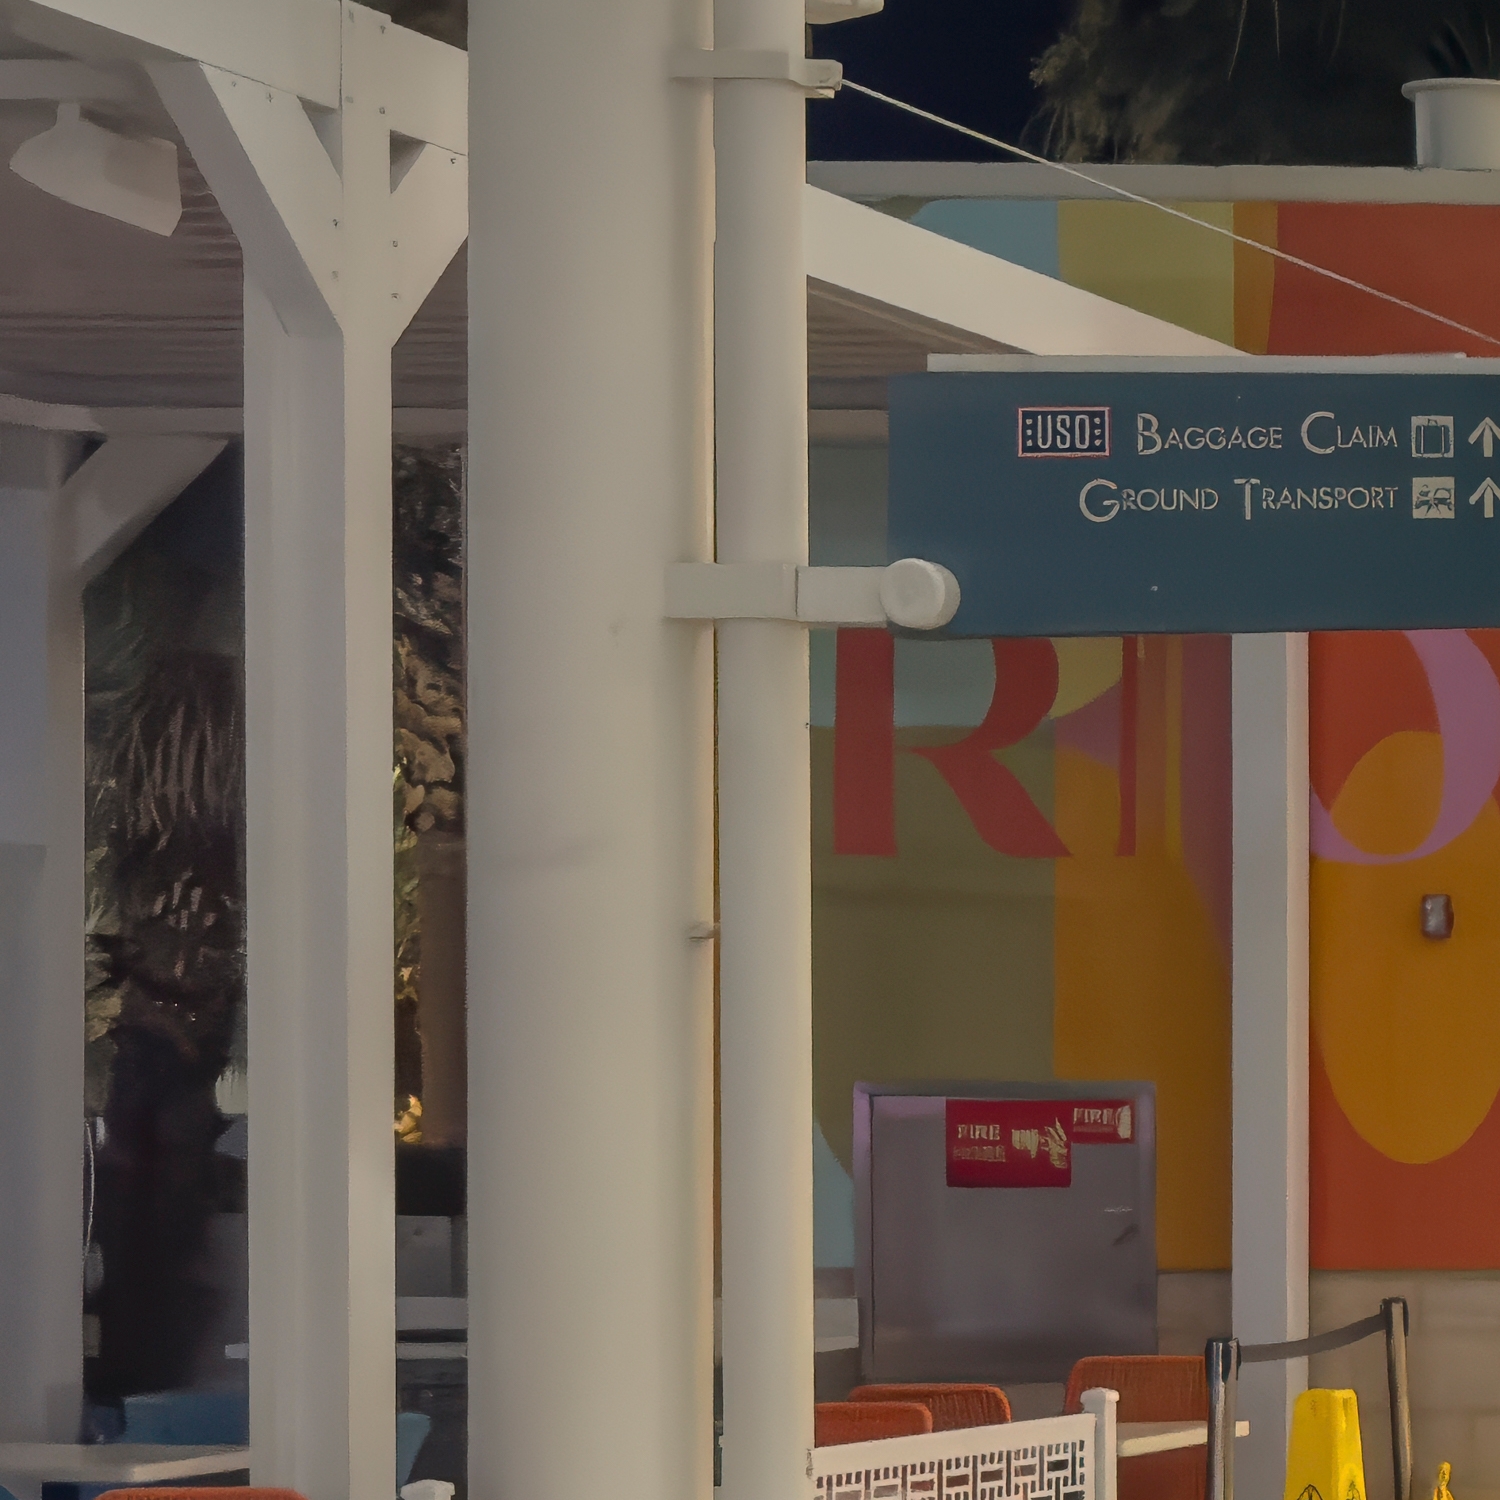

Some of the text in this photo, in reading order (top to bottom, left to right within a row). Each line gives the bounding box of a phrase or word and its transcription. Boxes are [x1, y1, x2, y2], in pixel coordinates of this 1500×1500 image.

[1036, 413, 1091, 449] USO
[1137, 411, 1397, 455] BAGGAGE CLAIM
[1079, 478, 1398, 522] GROUND TRANSPORT
